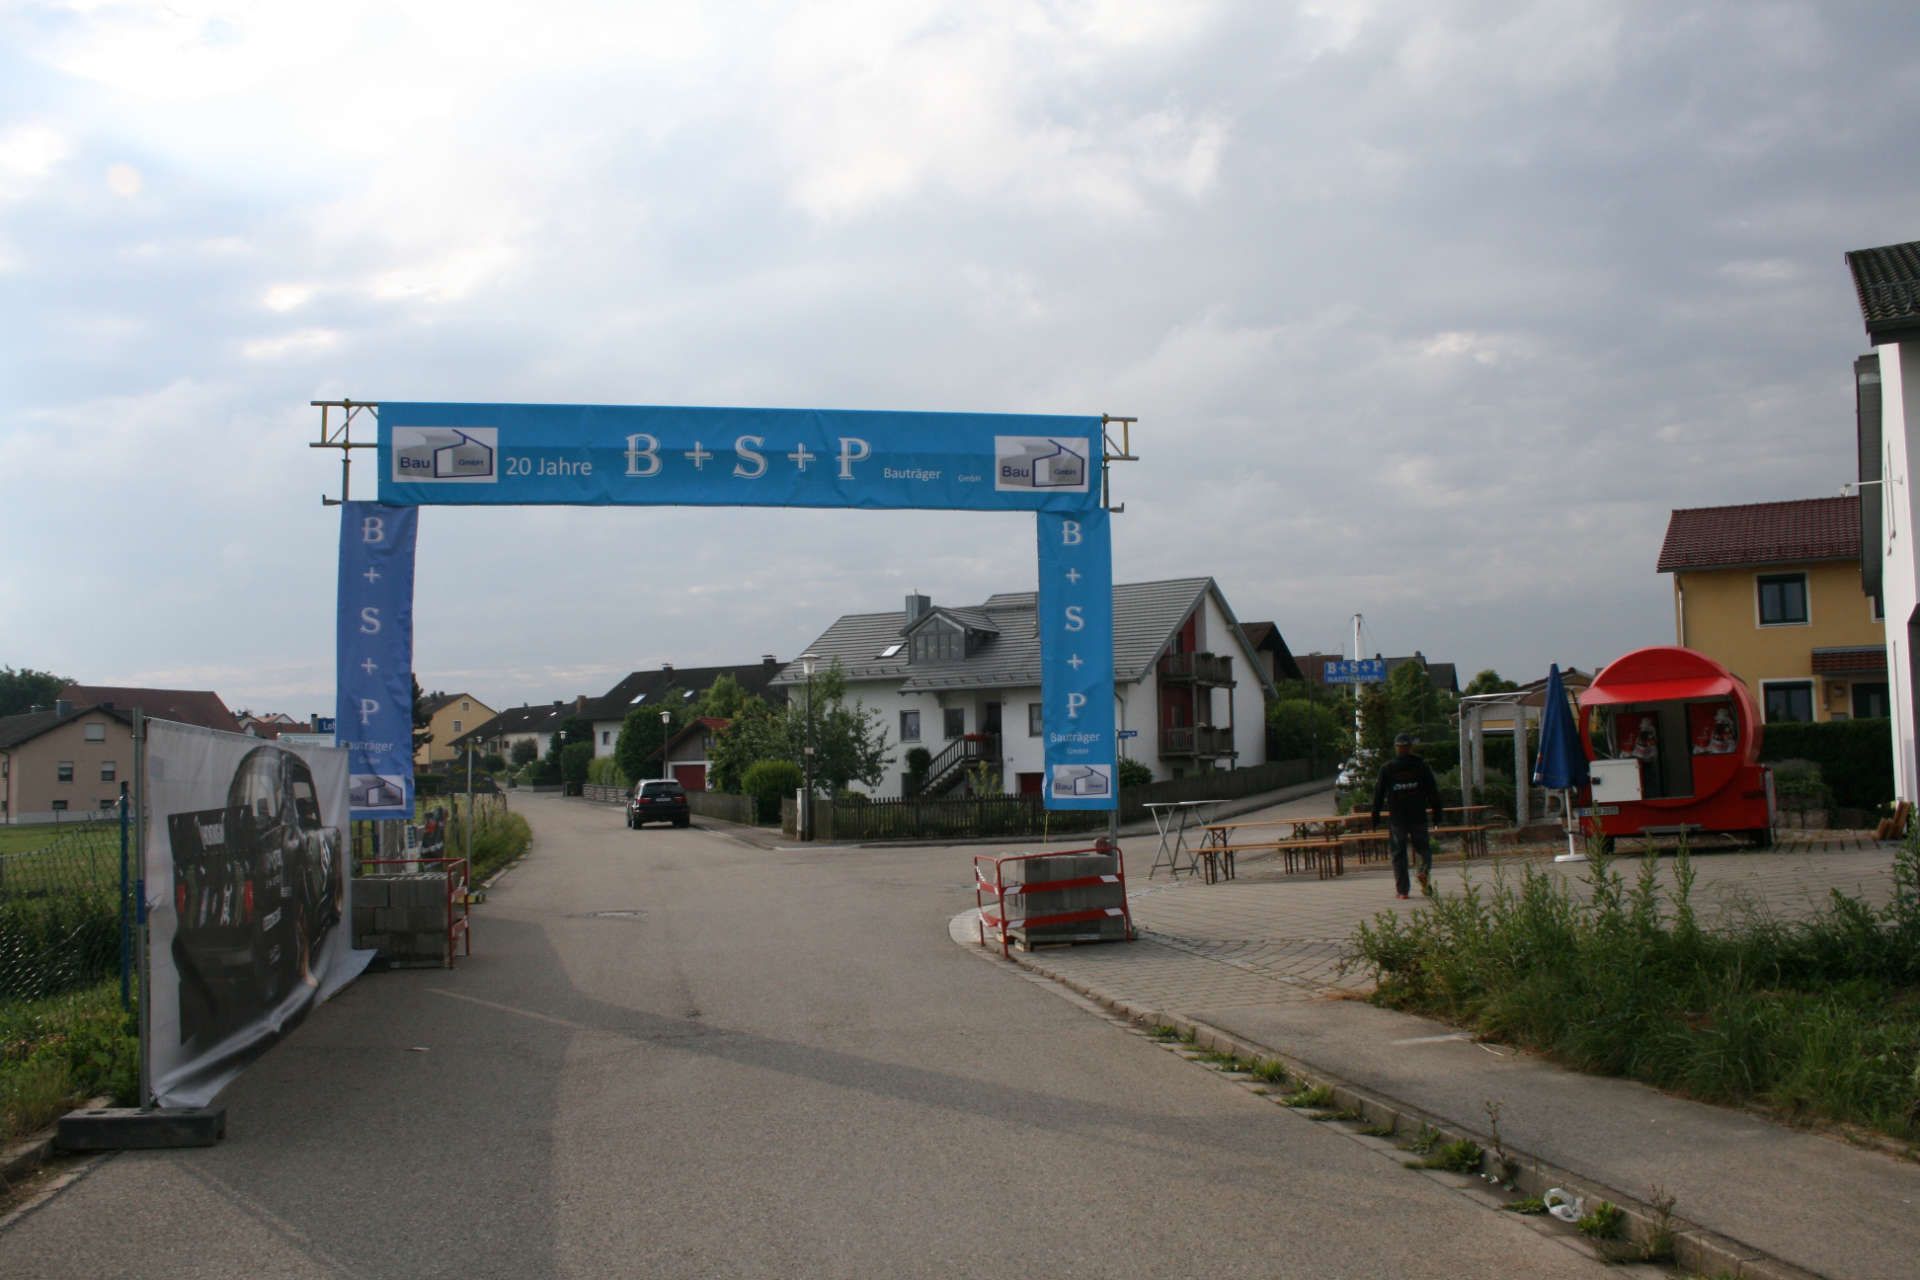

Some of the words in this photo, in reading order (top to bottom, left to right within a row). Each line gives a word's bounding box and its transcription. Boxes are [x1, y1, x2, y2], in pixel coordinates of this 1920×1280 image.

[400, 456, 431, 469] Bau
[505, 457, 533, 477] 20
[536, 456, 593, 477] Jahre
[623, 432, 663, 479] B
[732, 433, 769, 480] S
[836, 436, 872, 481] P
[883, 466, 943, 482] Bauträger
[1001, 465, 1030, 478] Bau
[362, 516, 385, 545] B
[1062, 520, 1083, 546] B
[359, 607, 382, 635] S
[1064, 605, 1085, 632] S
[359, 698, 380, 726] P
[1066, 692, 1087, 719] P
